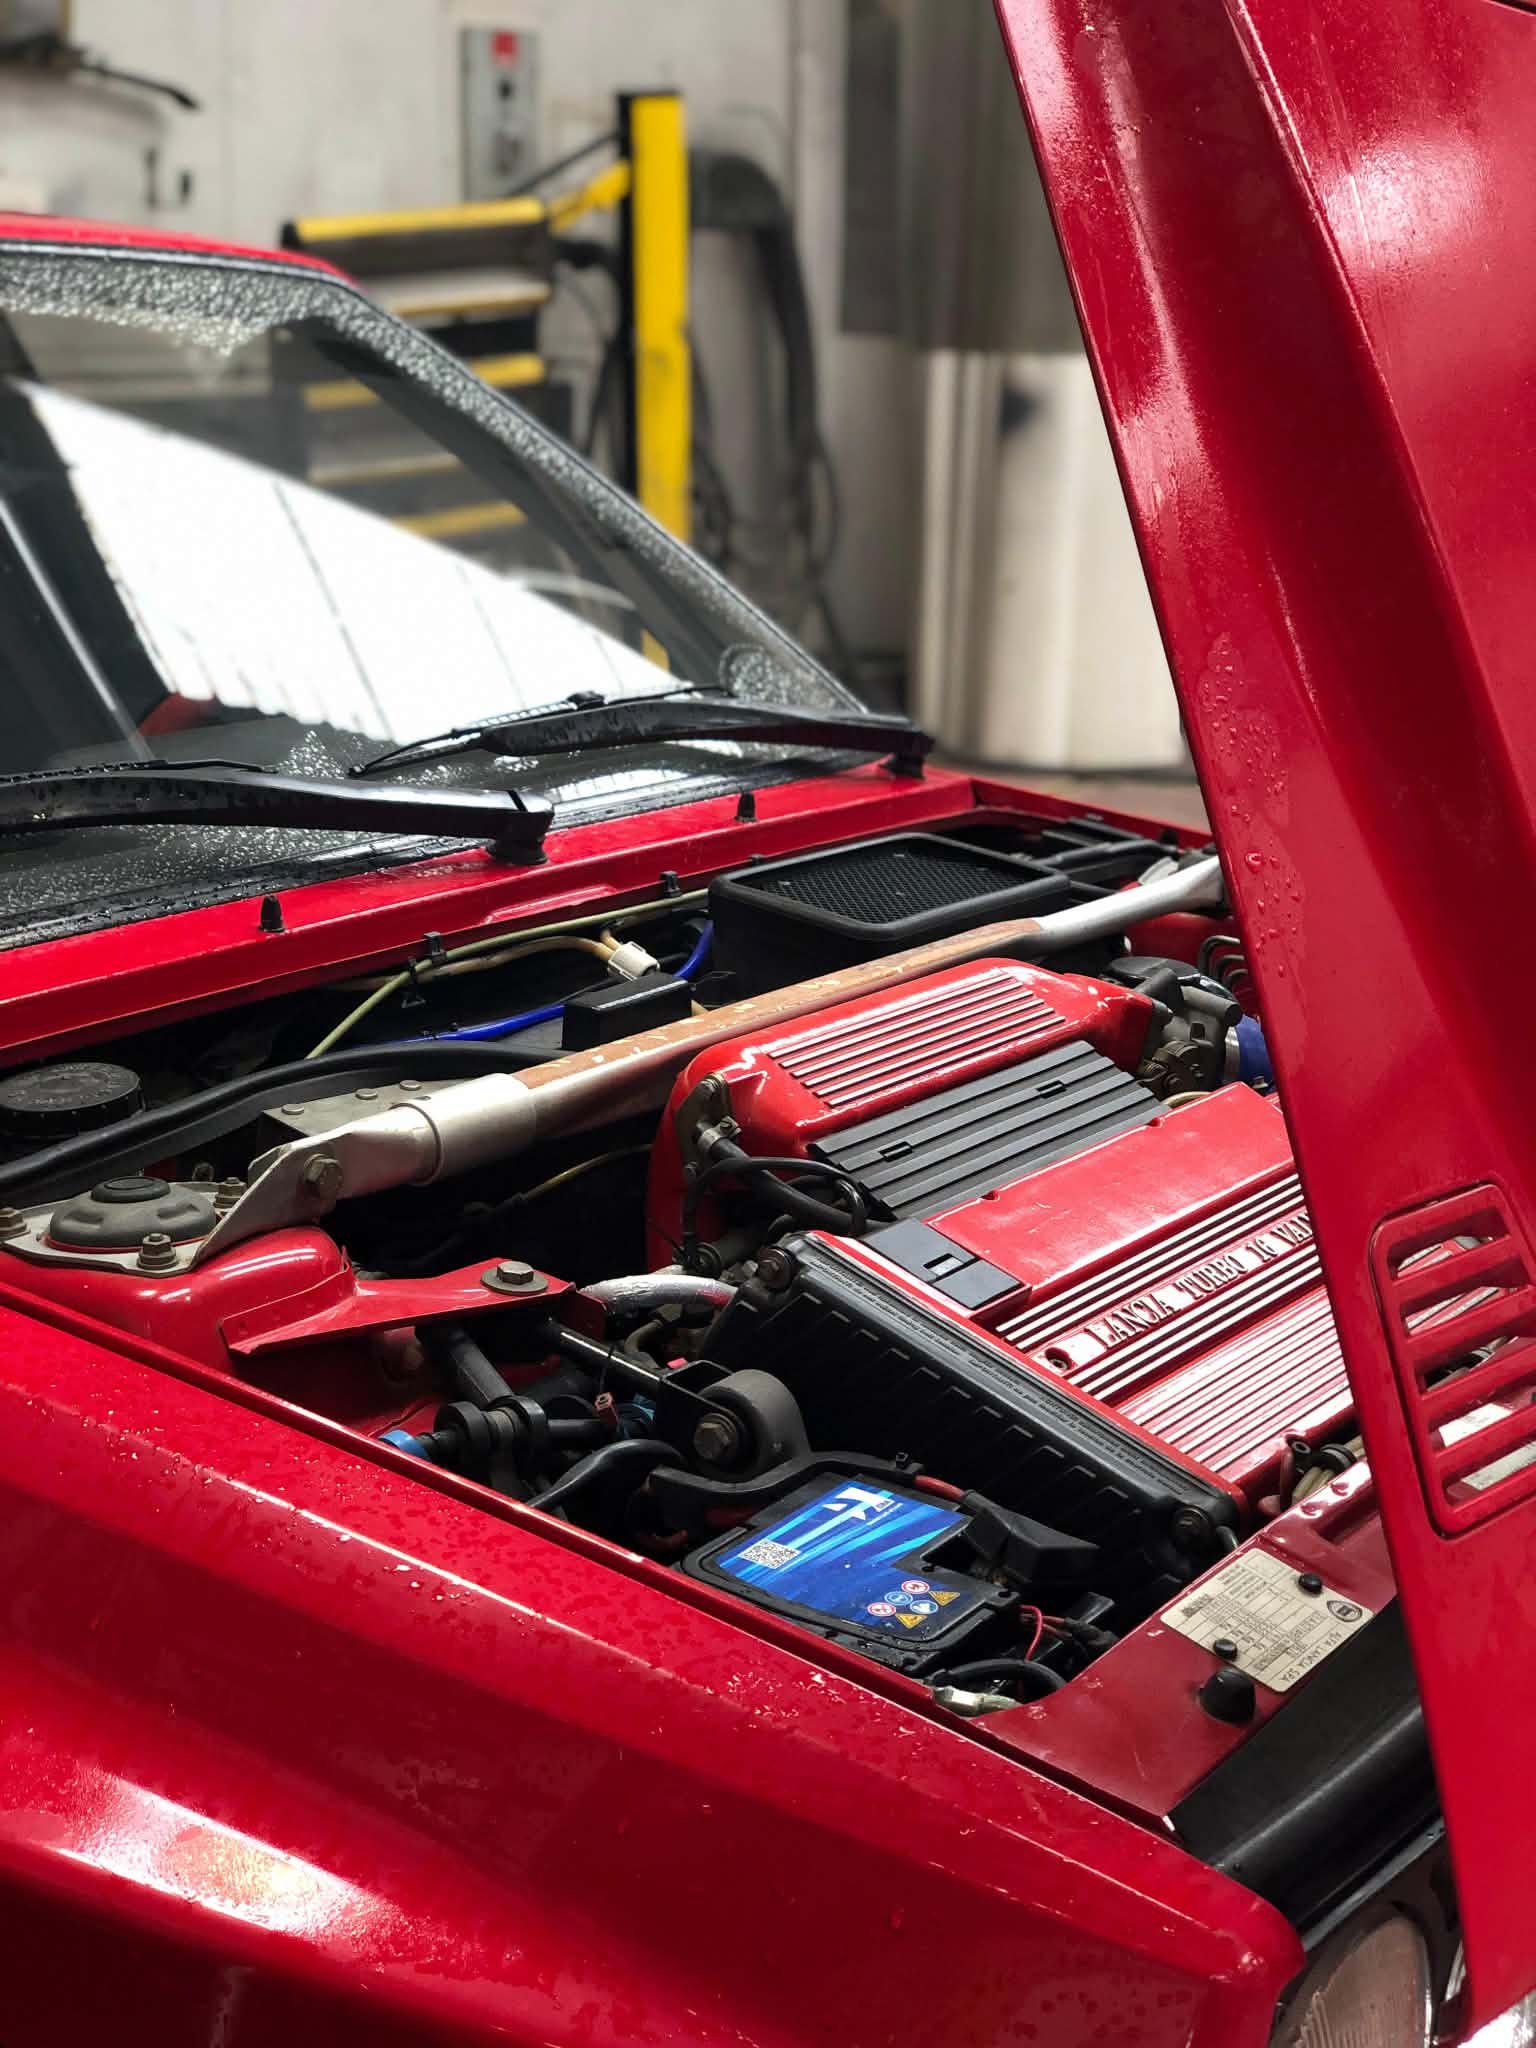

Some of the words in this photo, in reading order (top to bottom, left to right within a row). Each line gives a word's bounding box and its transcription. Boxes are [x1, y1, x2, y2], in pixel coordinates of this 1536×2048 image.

[1084, 1294, 1181, 1351] LANCIA
[1174, 1254, 1248, 1300] TURBO
[1246, 1236, 1278, 1262] 16
